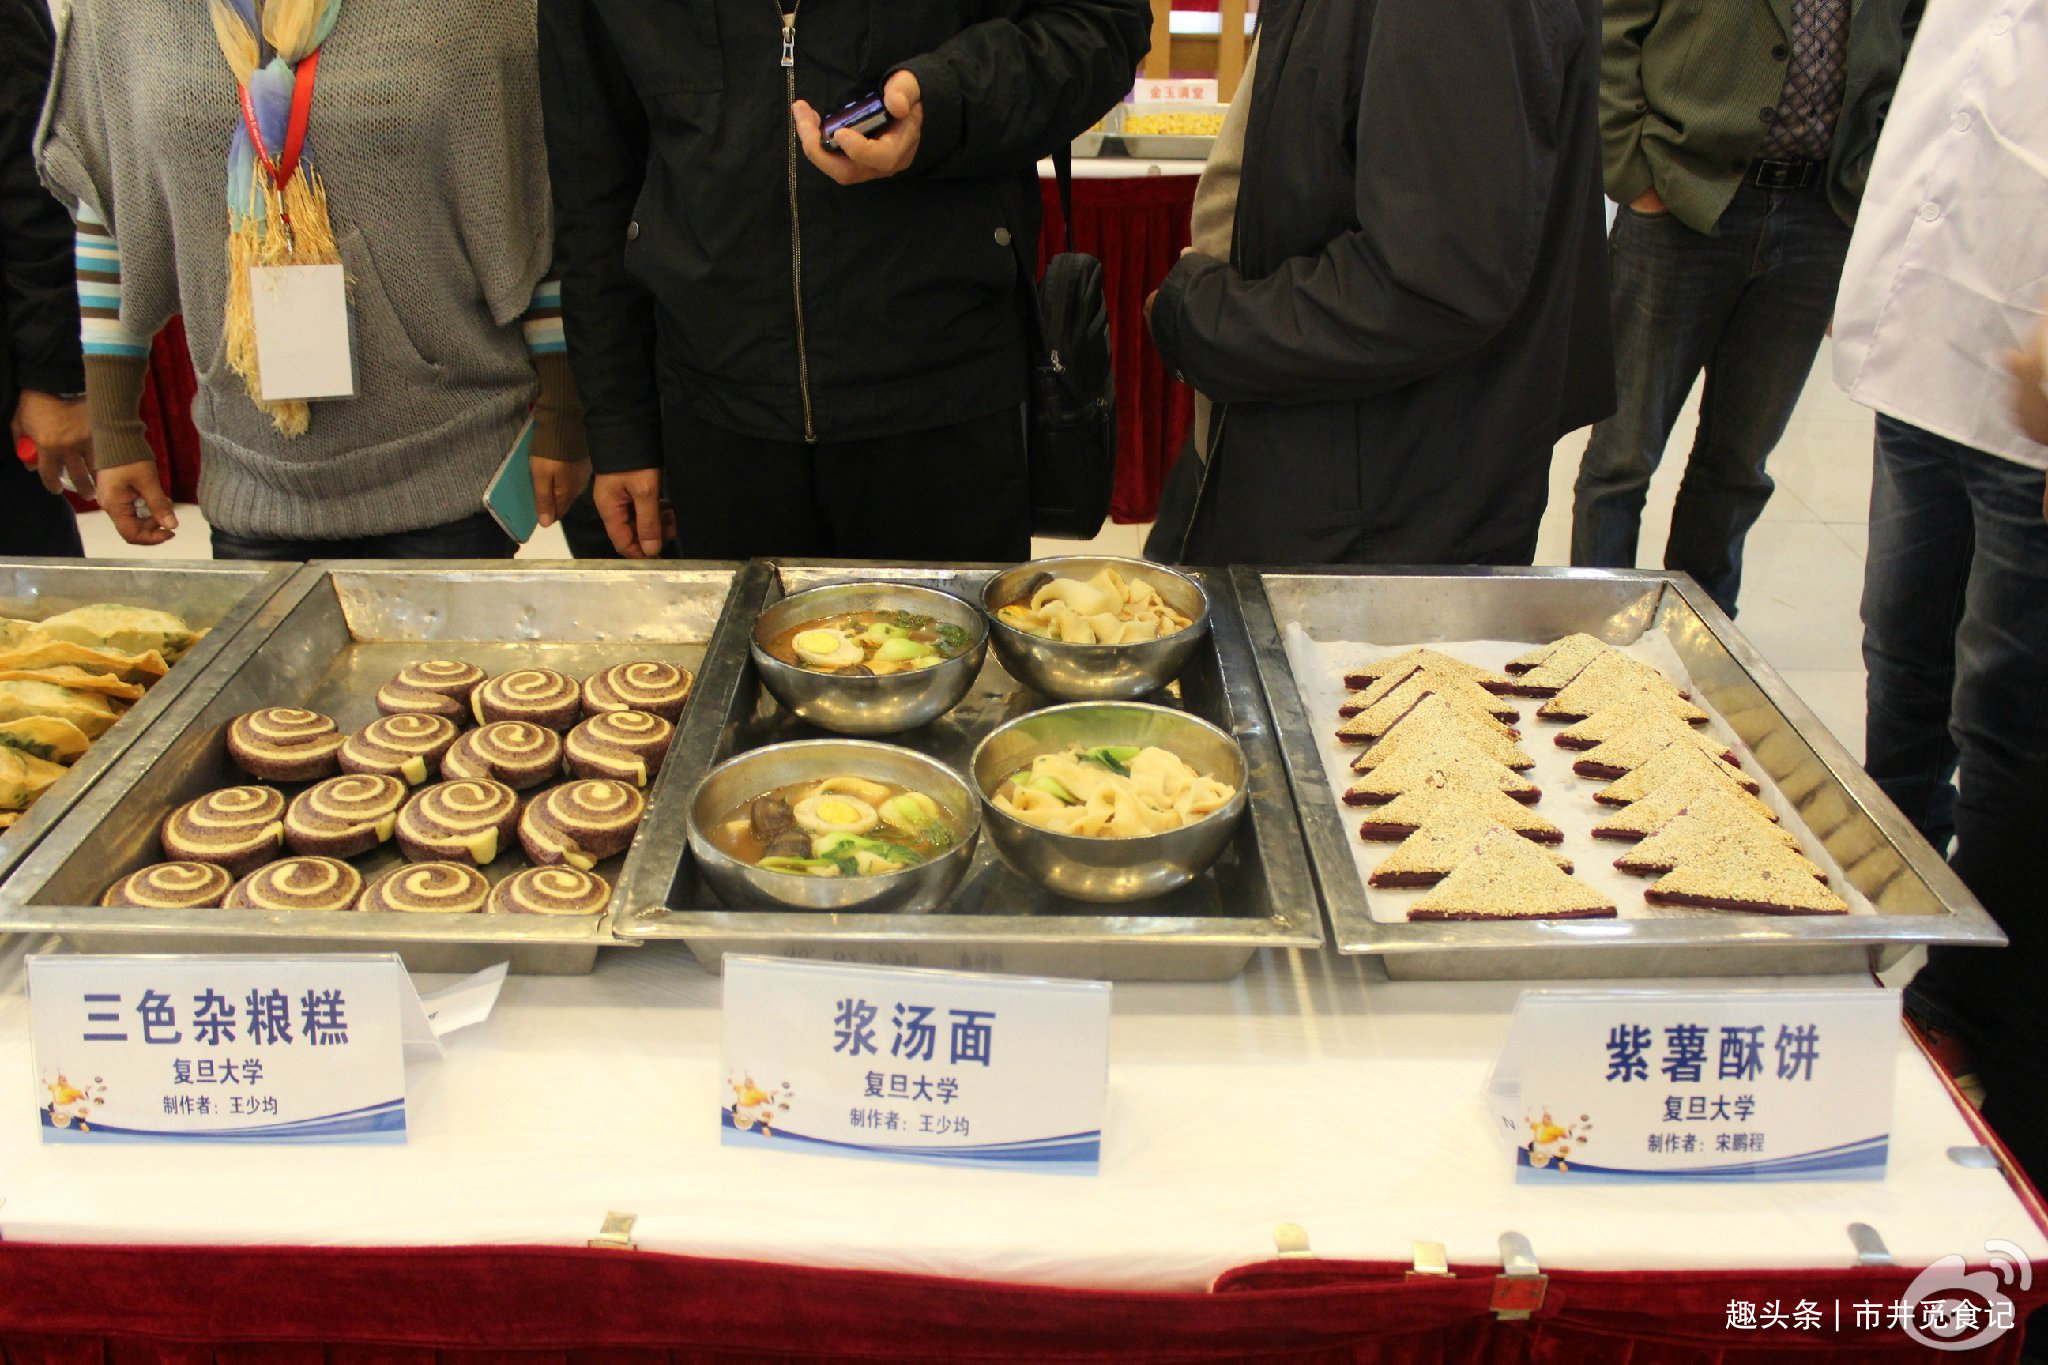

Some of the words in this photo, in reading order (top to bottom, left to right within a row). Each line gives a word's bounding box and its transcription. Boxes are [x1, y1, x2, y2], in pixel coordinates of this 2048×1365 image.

[83, 988, 349, 1046] 三色杂粮糕
[833, 998, 996, 1067] 浆汤面
[172, 1058, 264, 1085] 复旦大学
[1605, 1023, 1821, 1083] 紫薯酥饼
[863, 1070, 959, 1104] 复旦大学
[1663, 1095, 1756, 1122] 复旦大学
